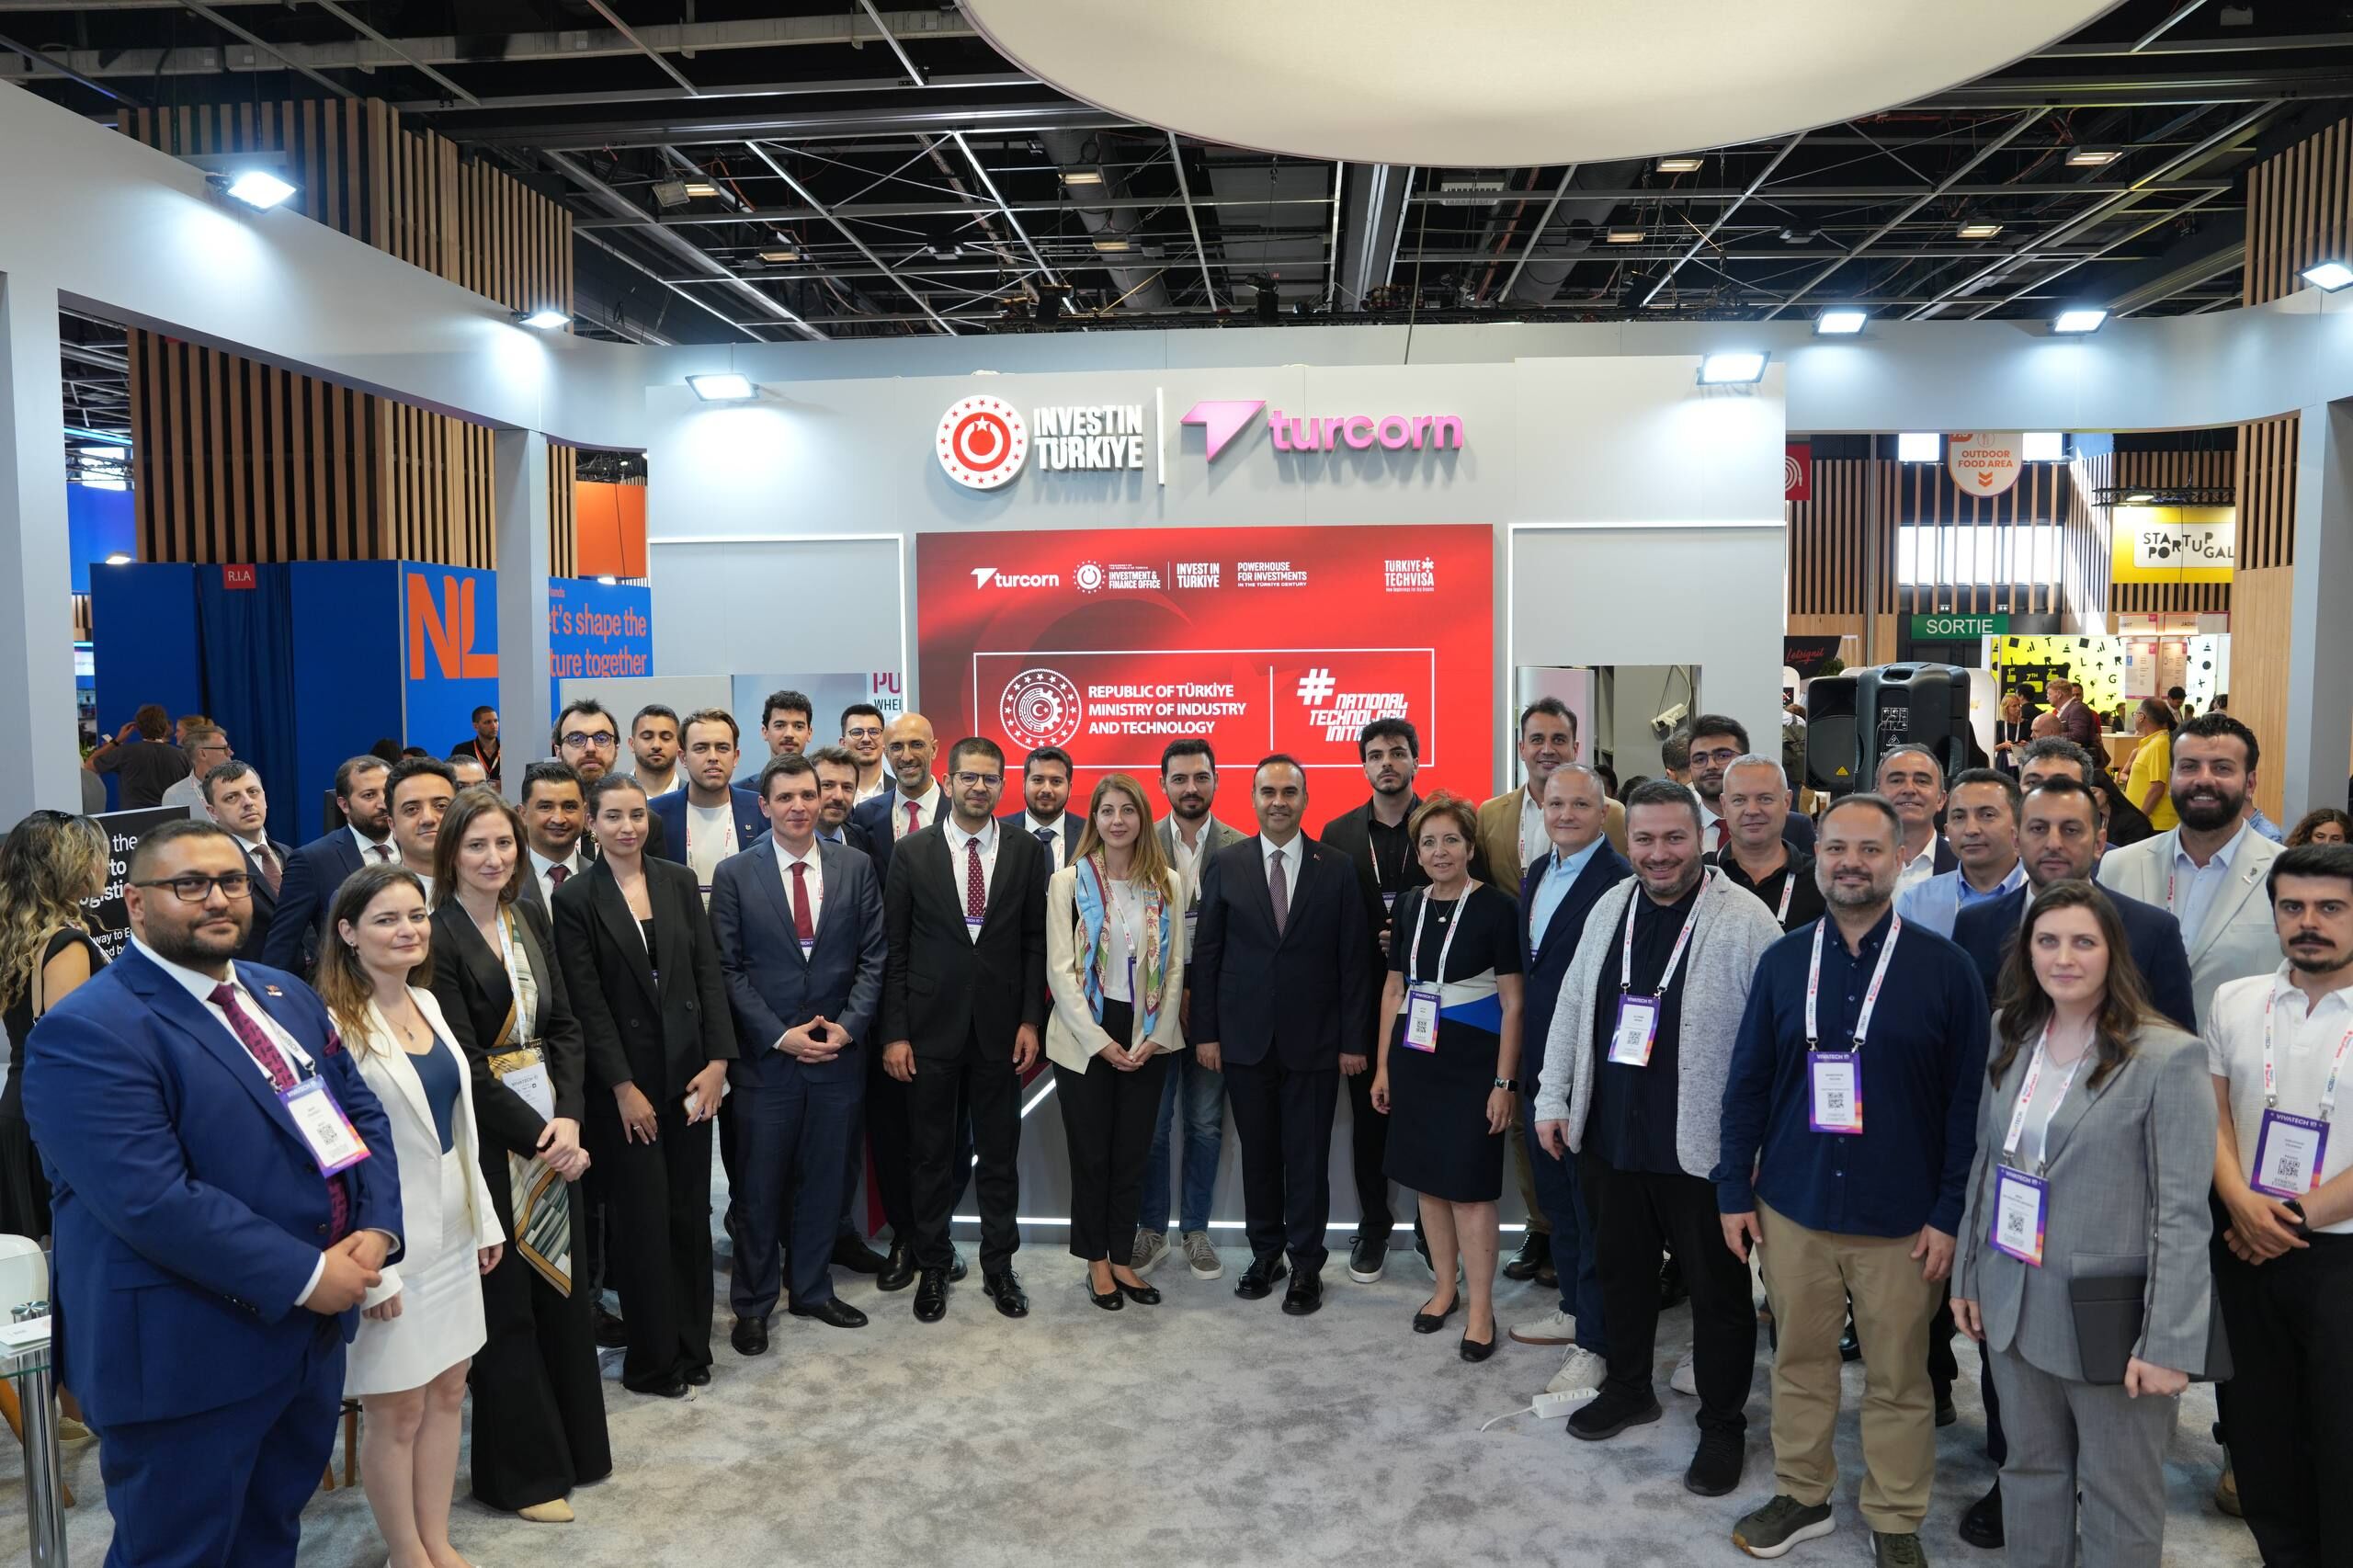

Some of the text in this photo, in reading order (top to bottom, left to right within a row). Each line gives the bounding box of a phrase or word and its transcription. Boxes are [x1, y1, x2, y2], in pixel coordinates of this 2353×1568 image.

[1267, 410, 1463, 450] turcorn
[1961, 449, 2010, 458] OUTDOOR
[1958, 460, 2013, 468] FOOD AREA
[1176, 562, 1220, 574] INVEST IN
[1237, 562, 1290, 572] POWERHOUSE
[228, 571, 251, 582] R.I.A
[995, 573, 1059, 587] turcorn
[1108, 571, 1151, 580] INVESTMENT
[1237, 571, 1307, 581] FOR INVESTMENTS
[1384, 572, 1435, 586] TECHVISA
[1108, 579, 1161, 589] FINANCE OFFICE
[407, 573, 499, 680] NL
[575, 603, 622, 643] shape
[624, 607, 647, 636] the
[1927, 619, 1994, 634] SORTIE
[585, 645, 647, 678] together
[1088, 682, 1234, 699] REPUBLIC OF TÜRKİYE
[1335, 693, 1408, 710] NATIONAL
[1088, 702, 1246, 717] MINISTRY OF INDUSTRY
[1088, 721, 1215, 734] AND TECHNOLOGY
[112, 833, 138, 853] the
